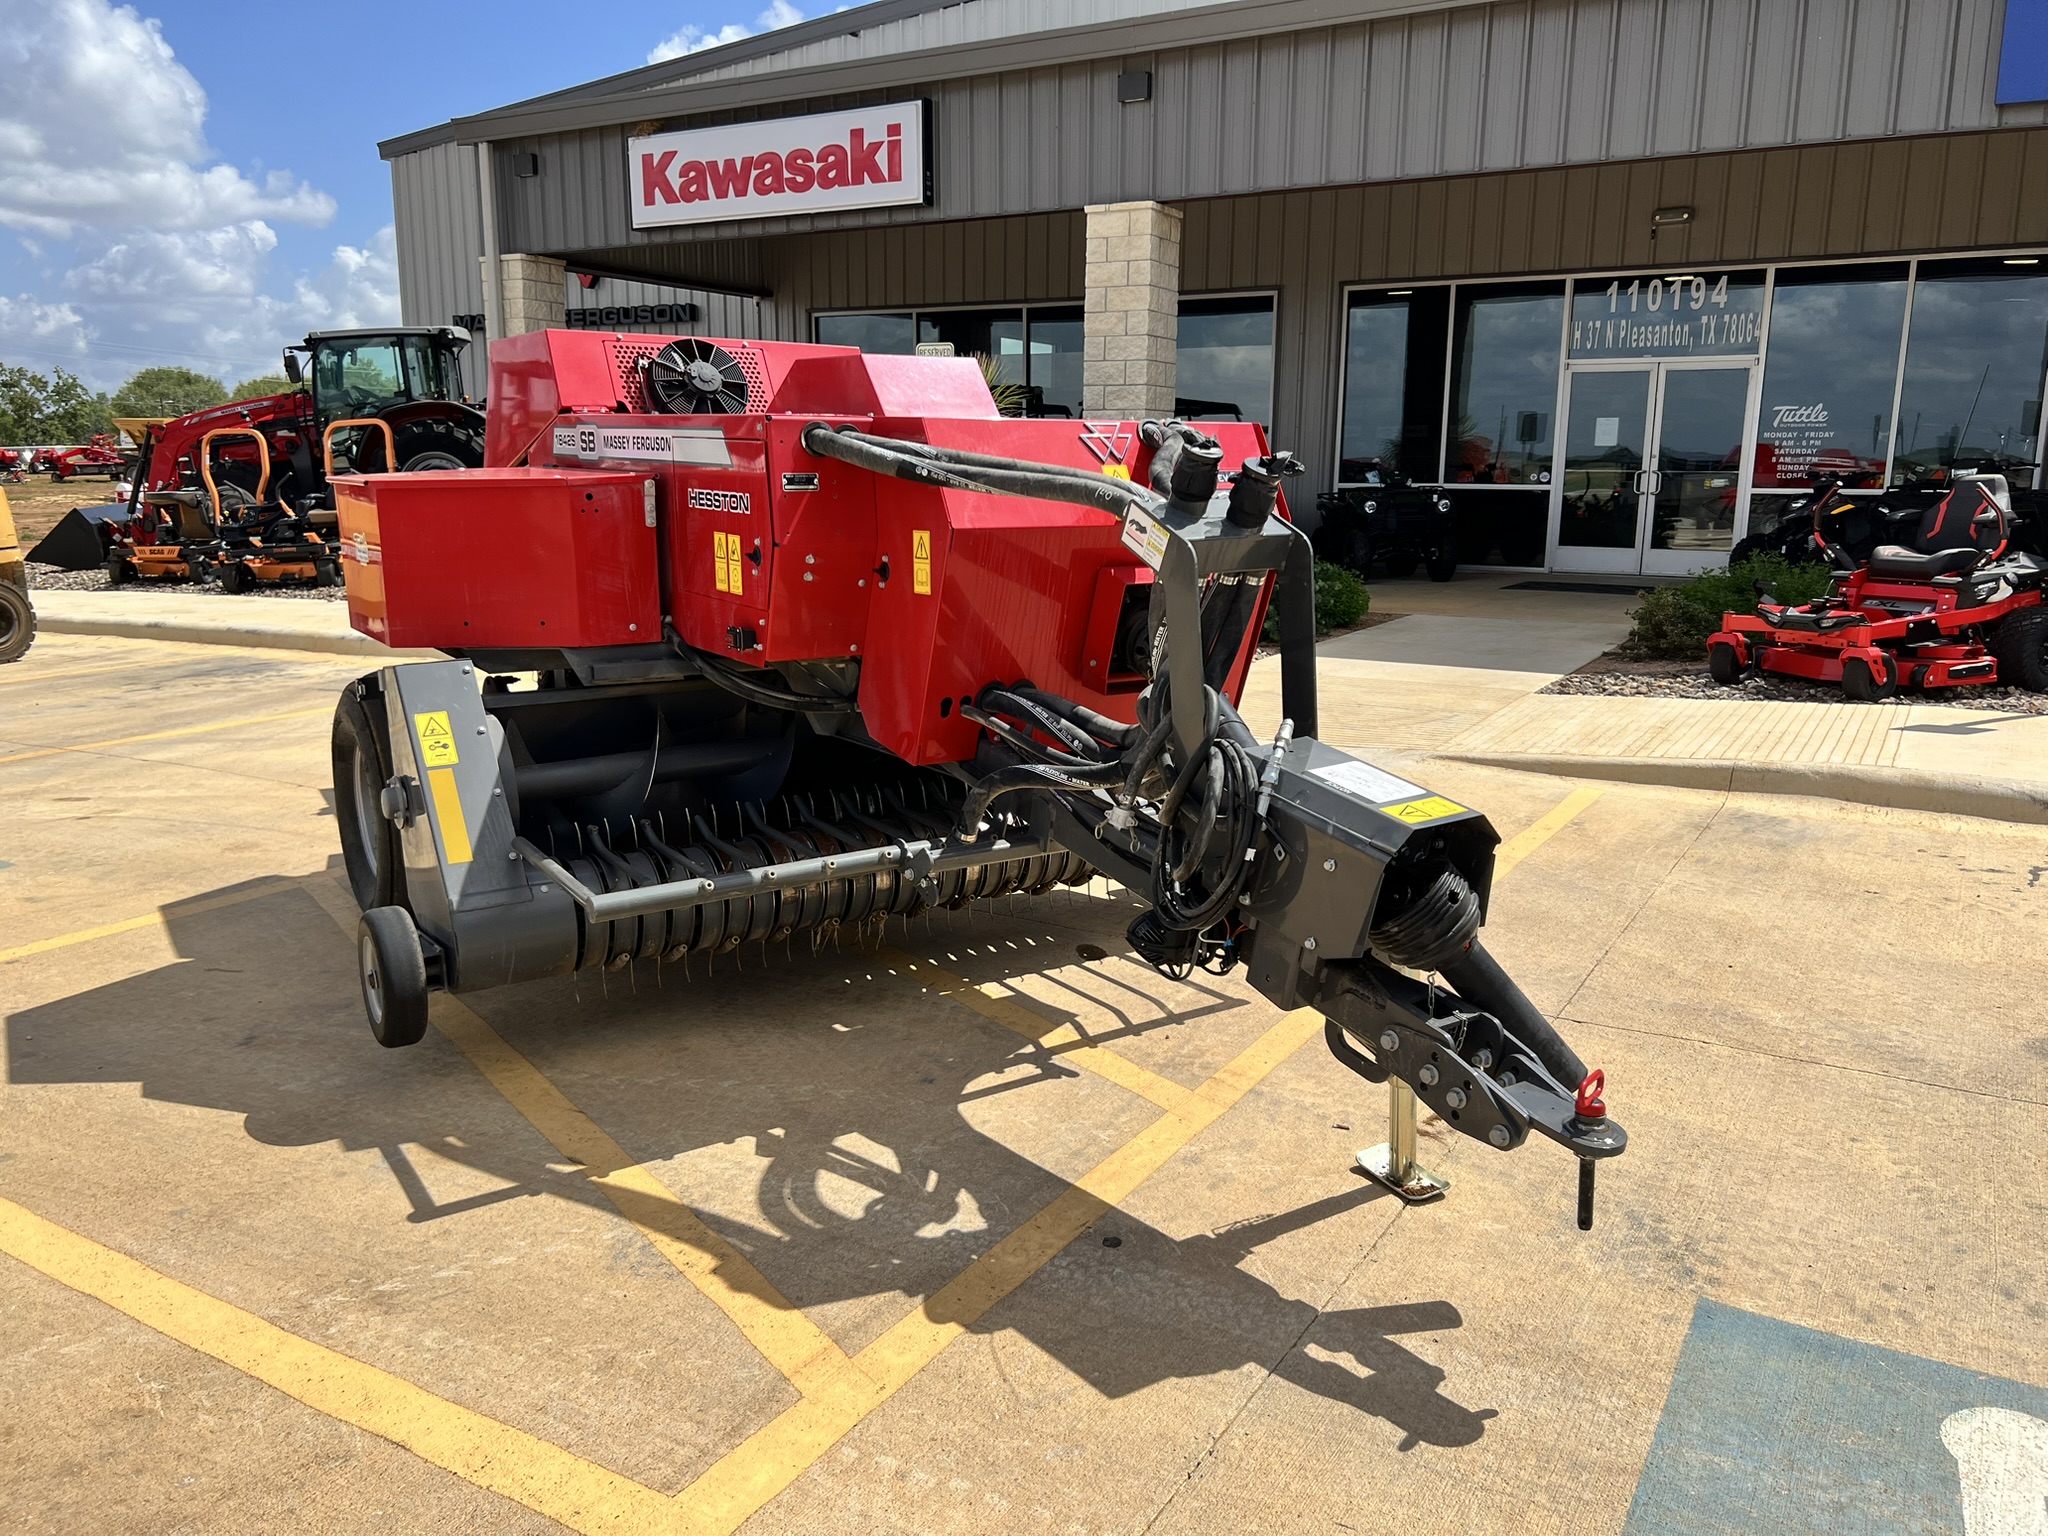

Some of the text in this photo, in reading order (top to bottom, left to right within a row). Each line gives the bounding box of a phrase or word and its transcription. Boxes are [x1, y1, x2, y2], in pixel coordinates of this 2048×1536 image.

[642, 122, 902, 206] Kawasaki
[1606, 275, 1728, 313] 110194
[566, 303, 697, 328] ERGUSON
[1586, 320, 1601, 350] 37
[1605, 319, 1613, 349] N
[1619, 318, 1694, 352] Pleasanton,
[1701, 314, 1717, 345] TX
[1722, 312, 1762, 345] 78064
[1772, 402, 1829, 428] Tuttle
[580, 430, 596, 453] SB
[603, 435, 631, 450] MASSEY
[632, 435, 671, 452] FERGUSON
[687, 488, 751, 515] HESSTON
